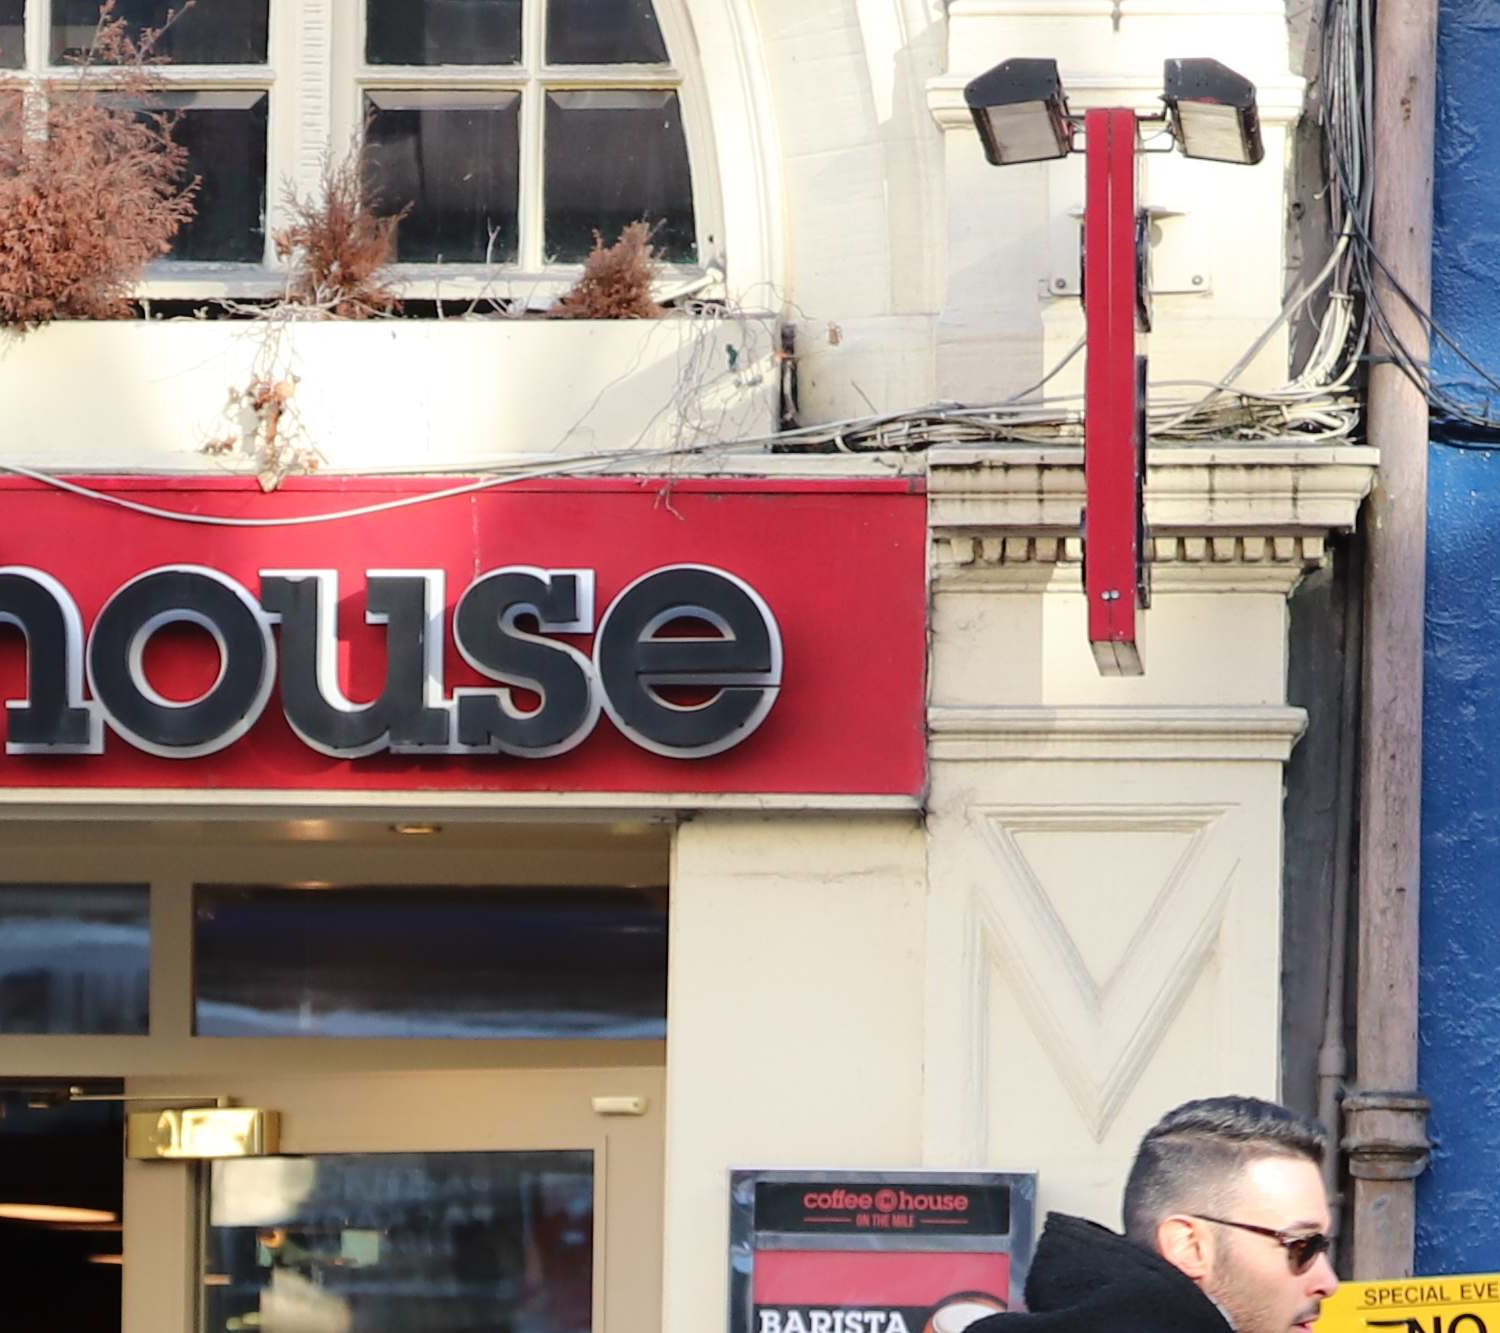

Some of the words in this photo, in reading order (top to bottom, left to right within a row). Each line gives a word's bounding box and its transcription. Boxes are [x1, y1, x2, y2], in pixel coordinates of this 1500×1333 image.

[803, 1189, 873, 1209] coffee
[900, 1190, 969, 1211] house
[1363, 1284, 1449, 1306] SPECIAL
